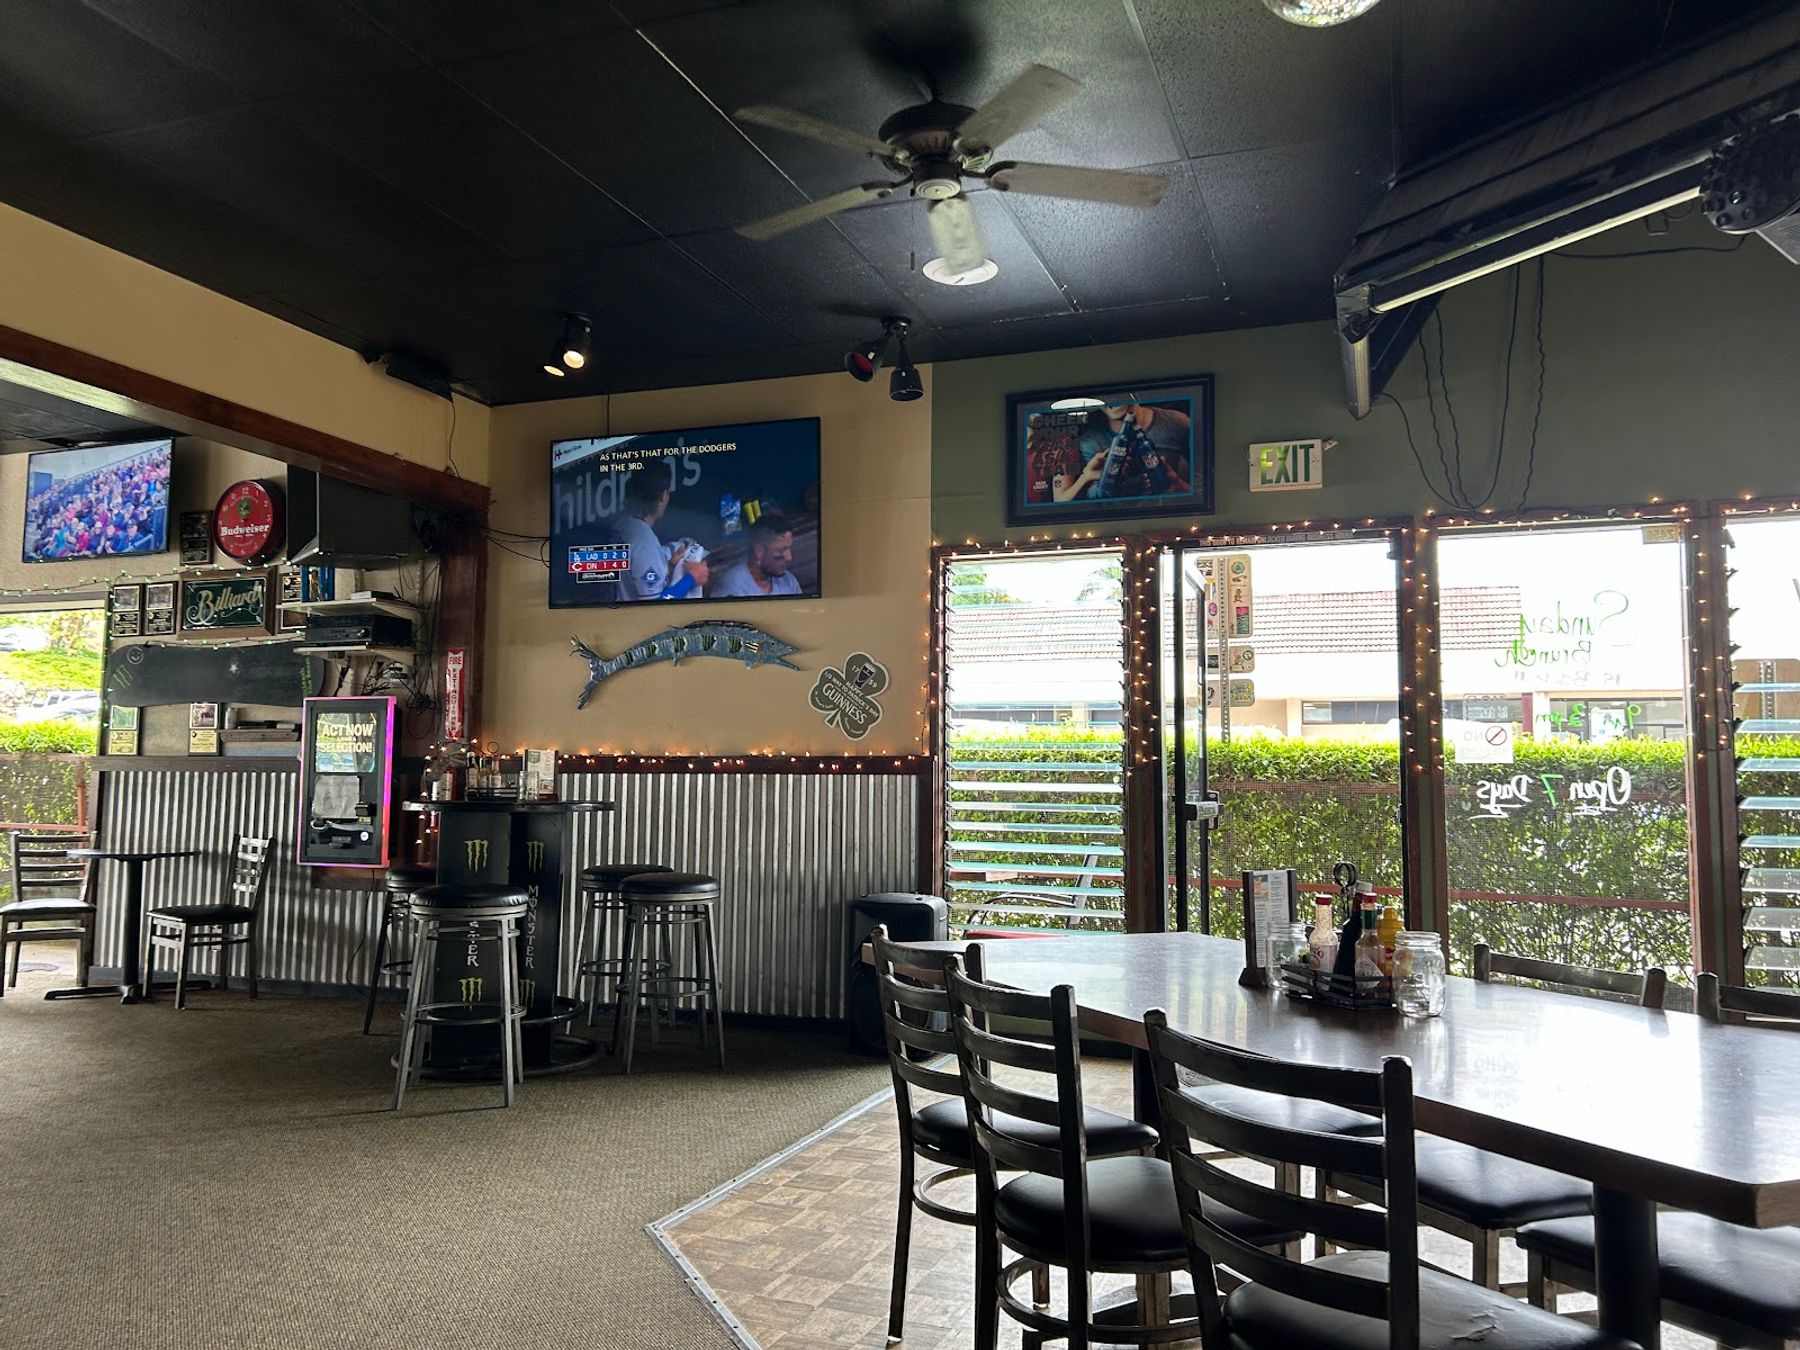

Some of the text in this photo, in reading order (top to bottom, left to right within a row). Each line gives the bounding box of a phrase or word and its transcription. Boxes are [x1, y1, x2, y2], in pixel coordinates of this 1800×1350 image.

[600, 442, 737, 461] AS THAT'S THAT FOR THE DODGERS
[600, 462, 645, 473] IN THE 3RD.
[1260, 443, 1315, 486] EXIT
[220, 523, 270, 537] Budweiser
[449, 656, 462, 665] FIRE
[822, 682, 868, 724] GUINNESS
[322, 723, 374, 737] ACT NOW
[319, 741, 373, 753] SELECTION!
[525, 884, 540, 969] MONSTER
